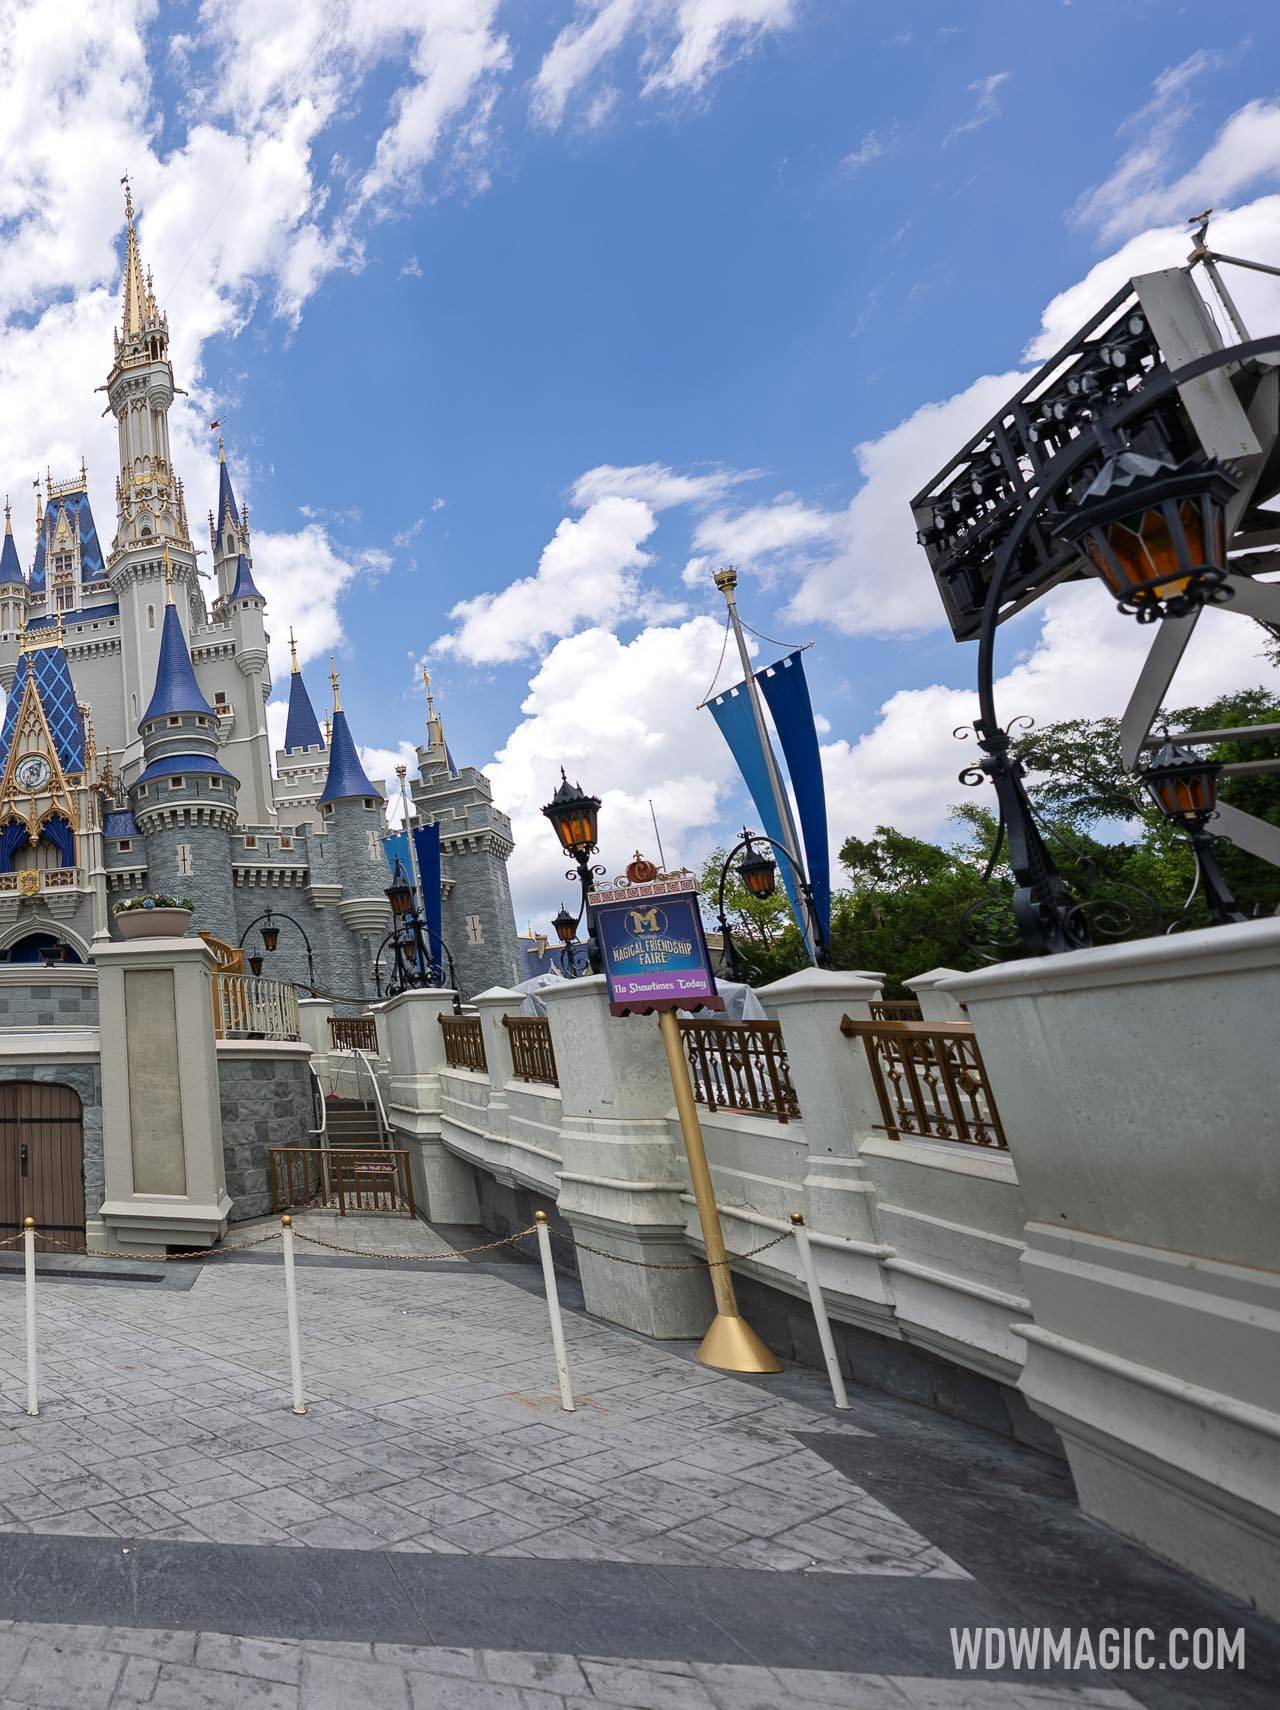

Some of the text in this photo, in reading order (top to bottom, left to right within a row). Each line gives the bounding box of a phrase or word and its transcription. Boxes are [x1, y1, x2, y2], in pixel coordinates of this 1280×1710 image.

[630, 908, 661, 934] M
[613, 939, 692, 962] MAGICAL FRIENDSHIP
[639, 952, 668, 965] FAIRE
[615, 979, 707, 994] No Showtimes Today
